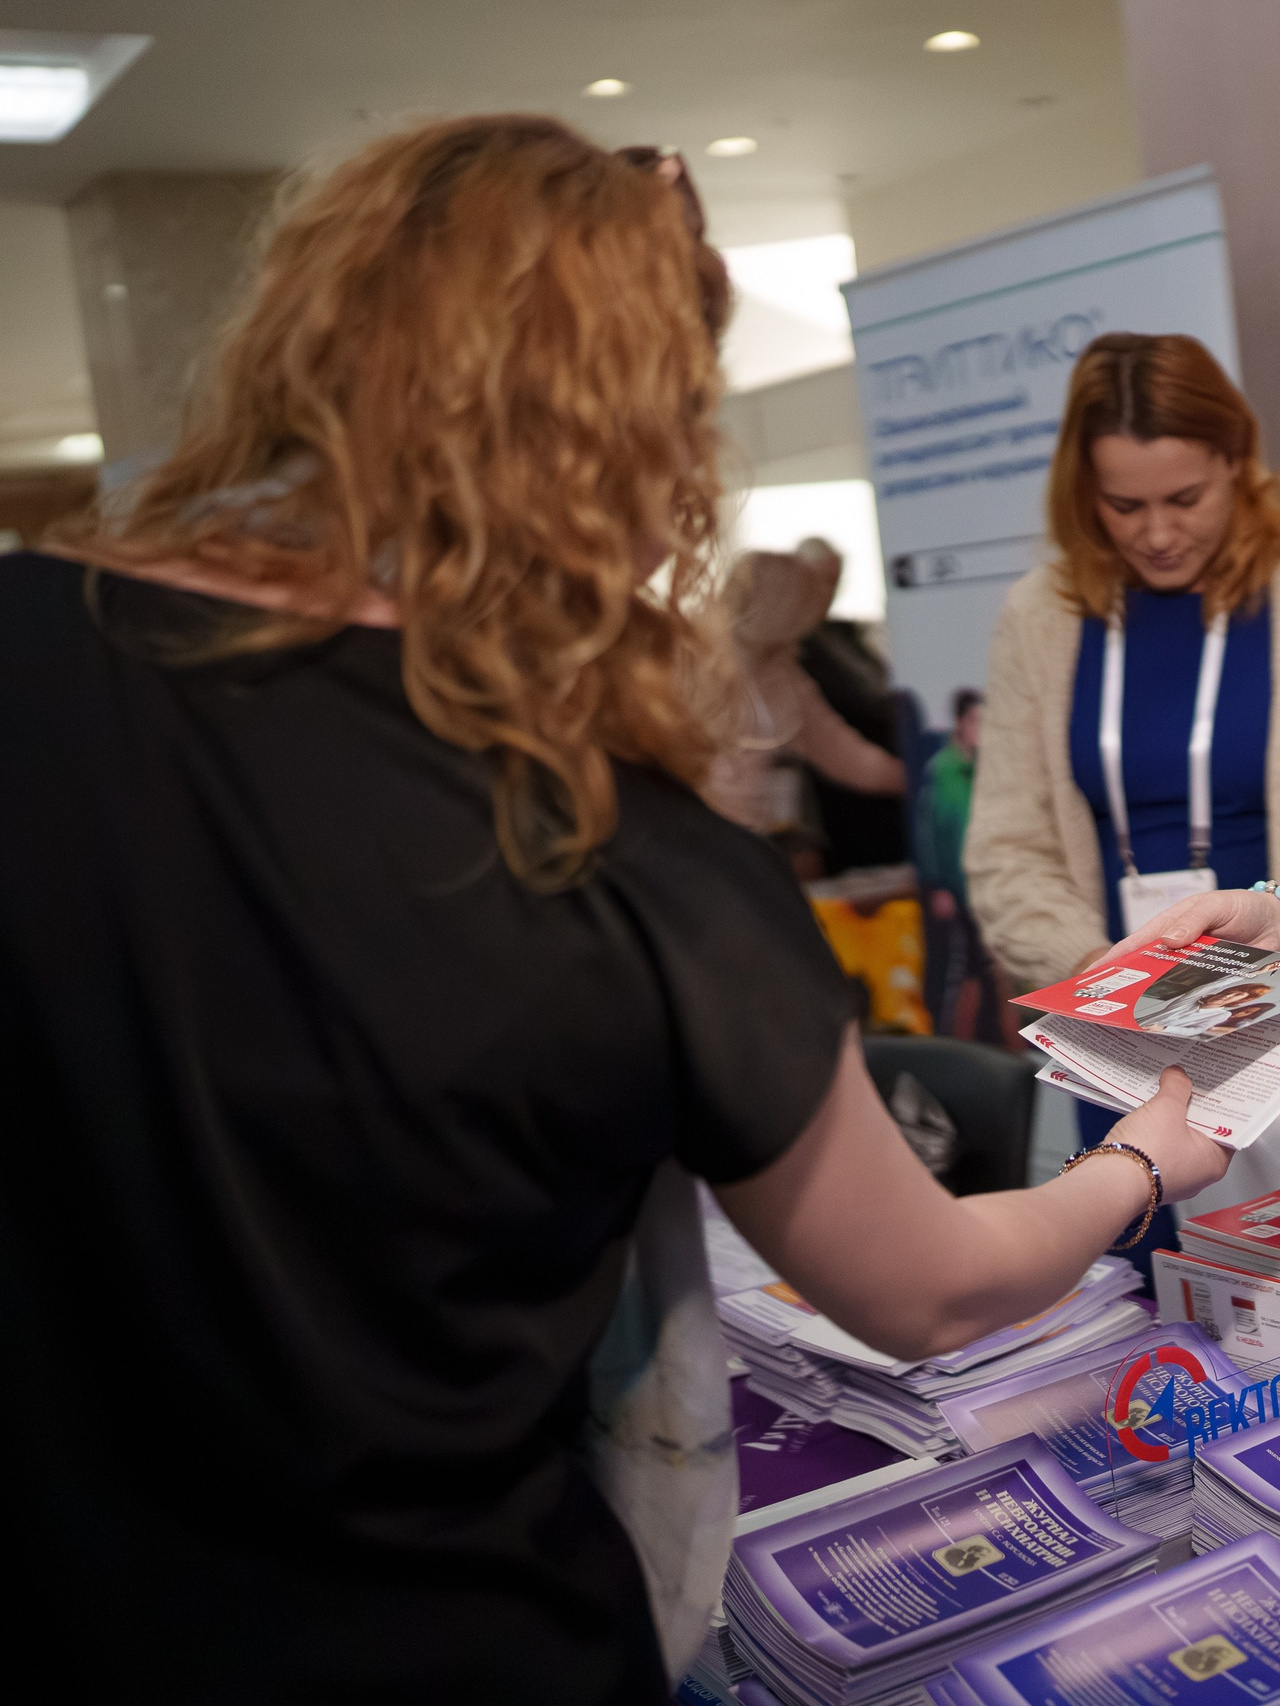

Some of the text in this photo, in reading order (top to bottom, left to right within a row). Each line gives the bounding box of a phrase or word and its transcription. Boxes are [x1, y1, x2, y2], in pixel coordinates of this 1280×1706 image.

[1204, 952, 1258, 970] поведения
[972, 1488, 993, 1501] И
[982, 1501, 1068, 1568] ПСИХИАТРИИ
[993, 1489, 1076, 1559] НЕВРОЛОГИИ
[1019, 1497, 1079, 1545] ЖУРНАЛ
